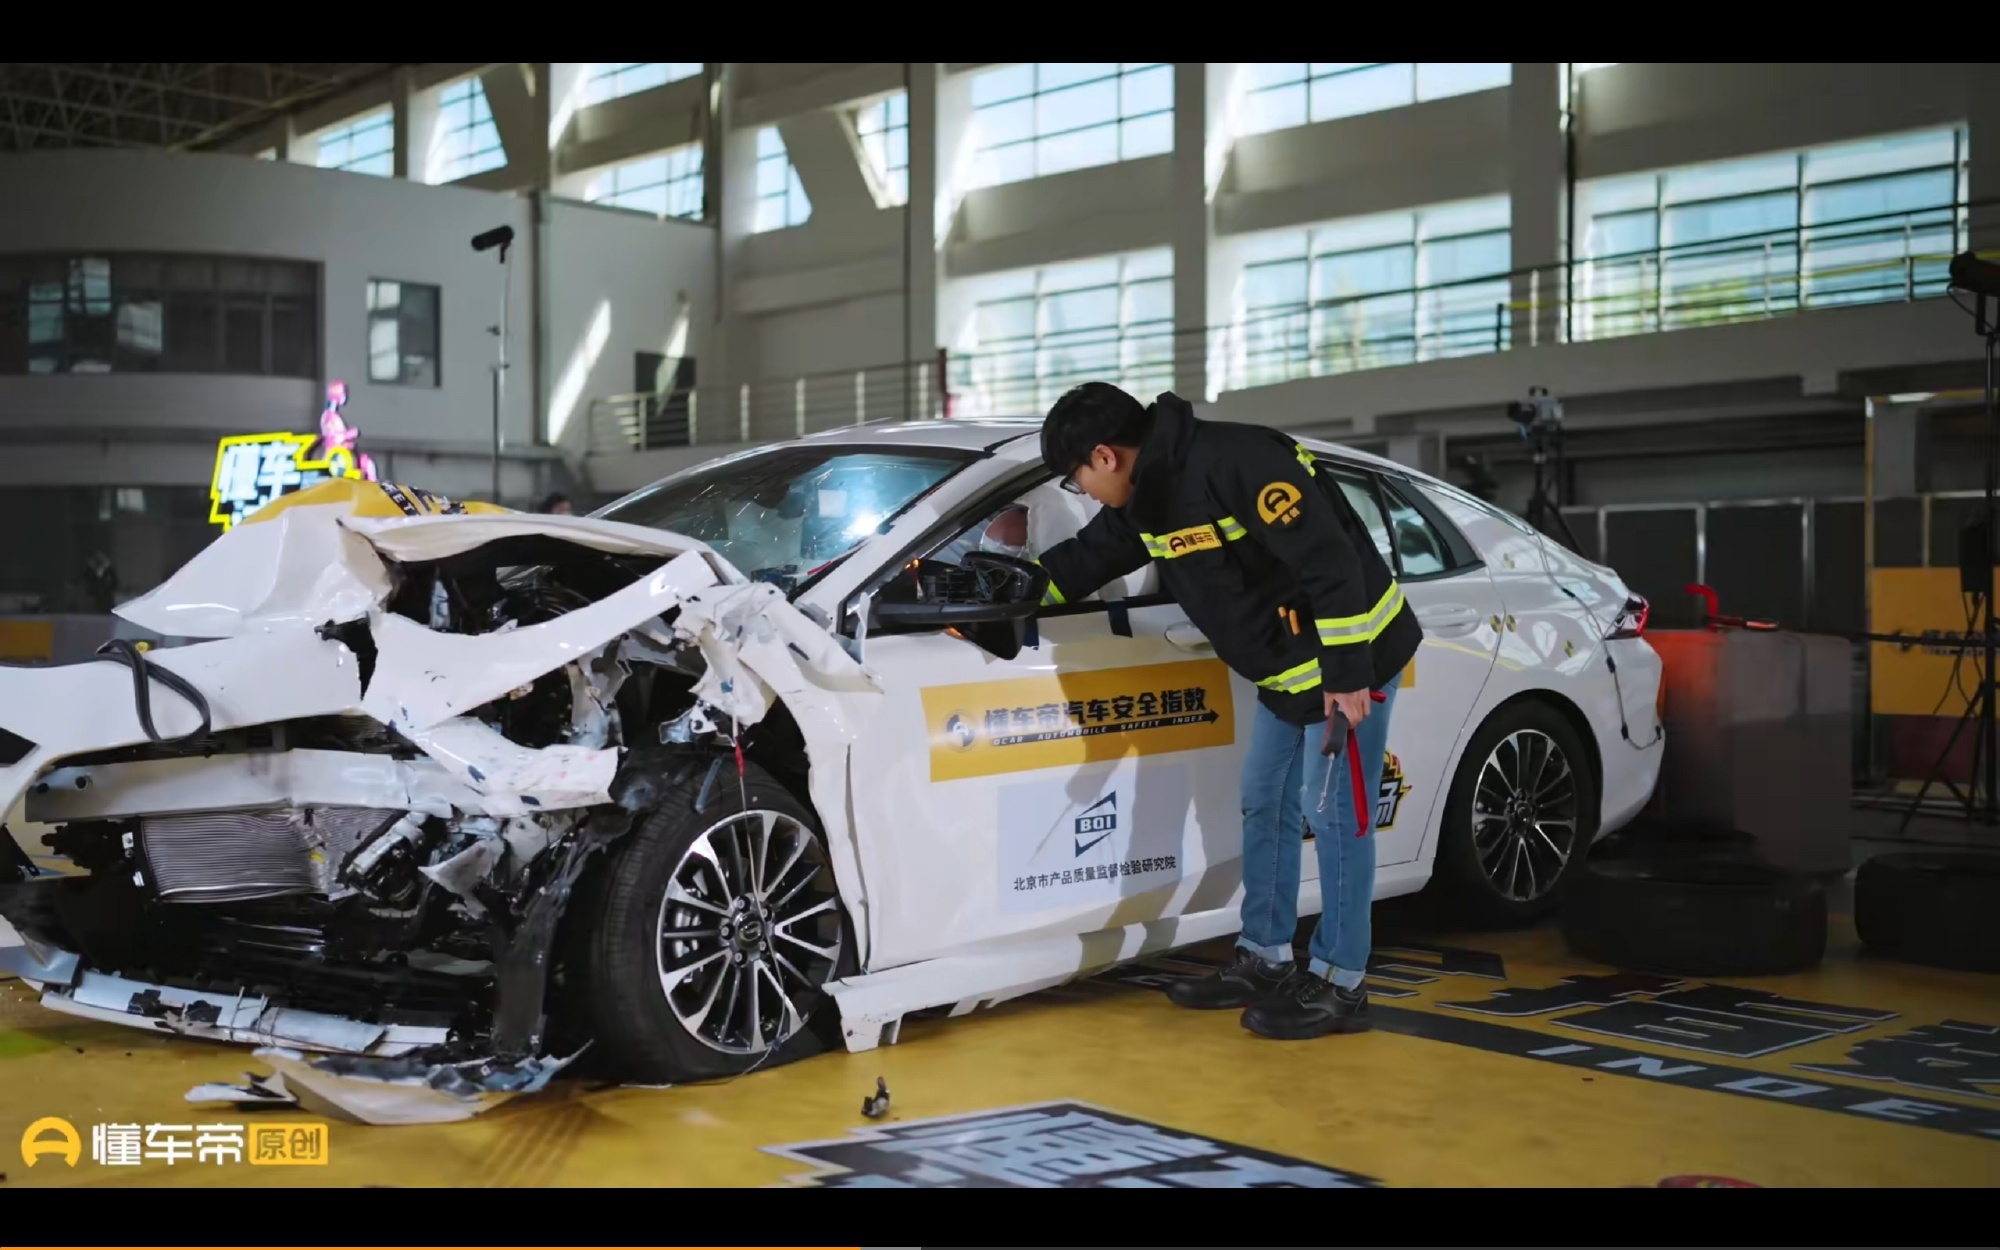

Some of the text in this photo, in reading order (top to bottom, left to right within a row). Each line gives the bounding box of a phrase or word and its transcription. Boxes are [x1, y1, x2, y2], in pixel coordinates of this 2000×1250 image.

[985, 687, 1206, 736] 懂车帝汽车安全指数
[1037, 726, 1108, 741] AUTOMOBILE
[1120, 719, 1161, 731] SAFETY
[1172, 714, 1204, 725] INDEX
[1014, 854, 1177, 892] 北京市产品质量监督检验研究院
[1526, 1043, 2000, 1136] INDE
